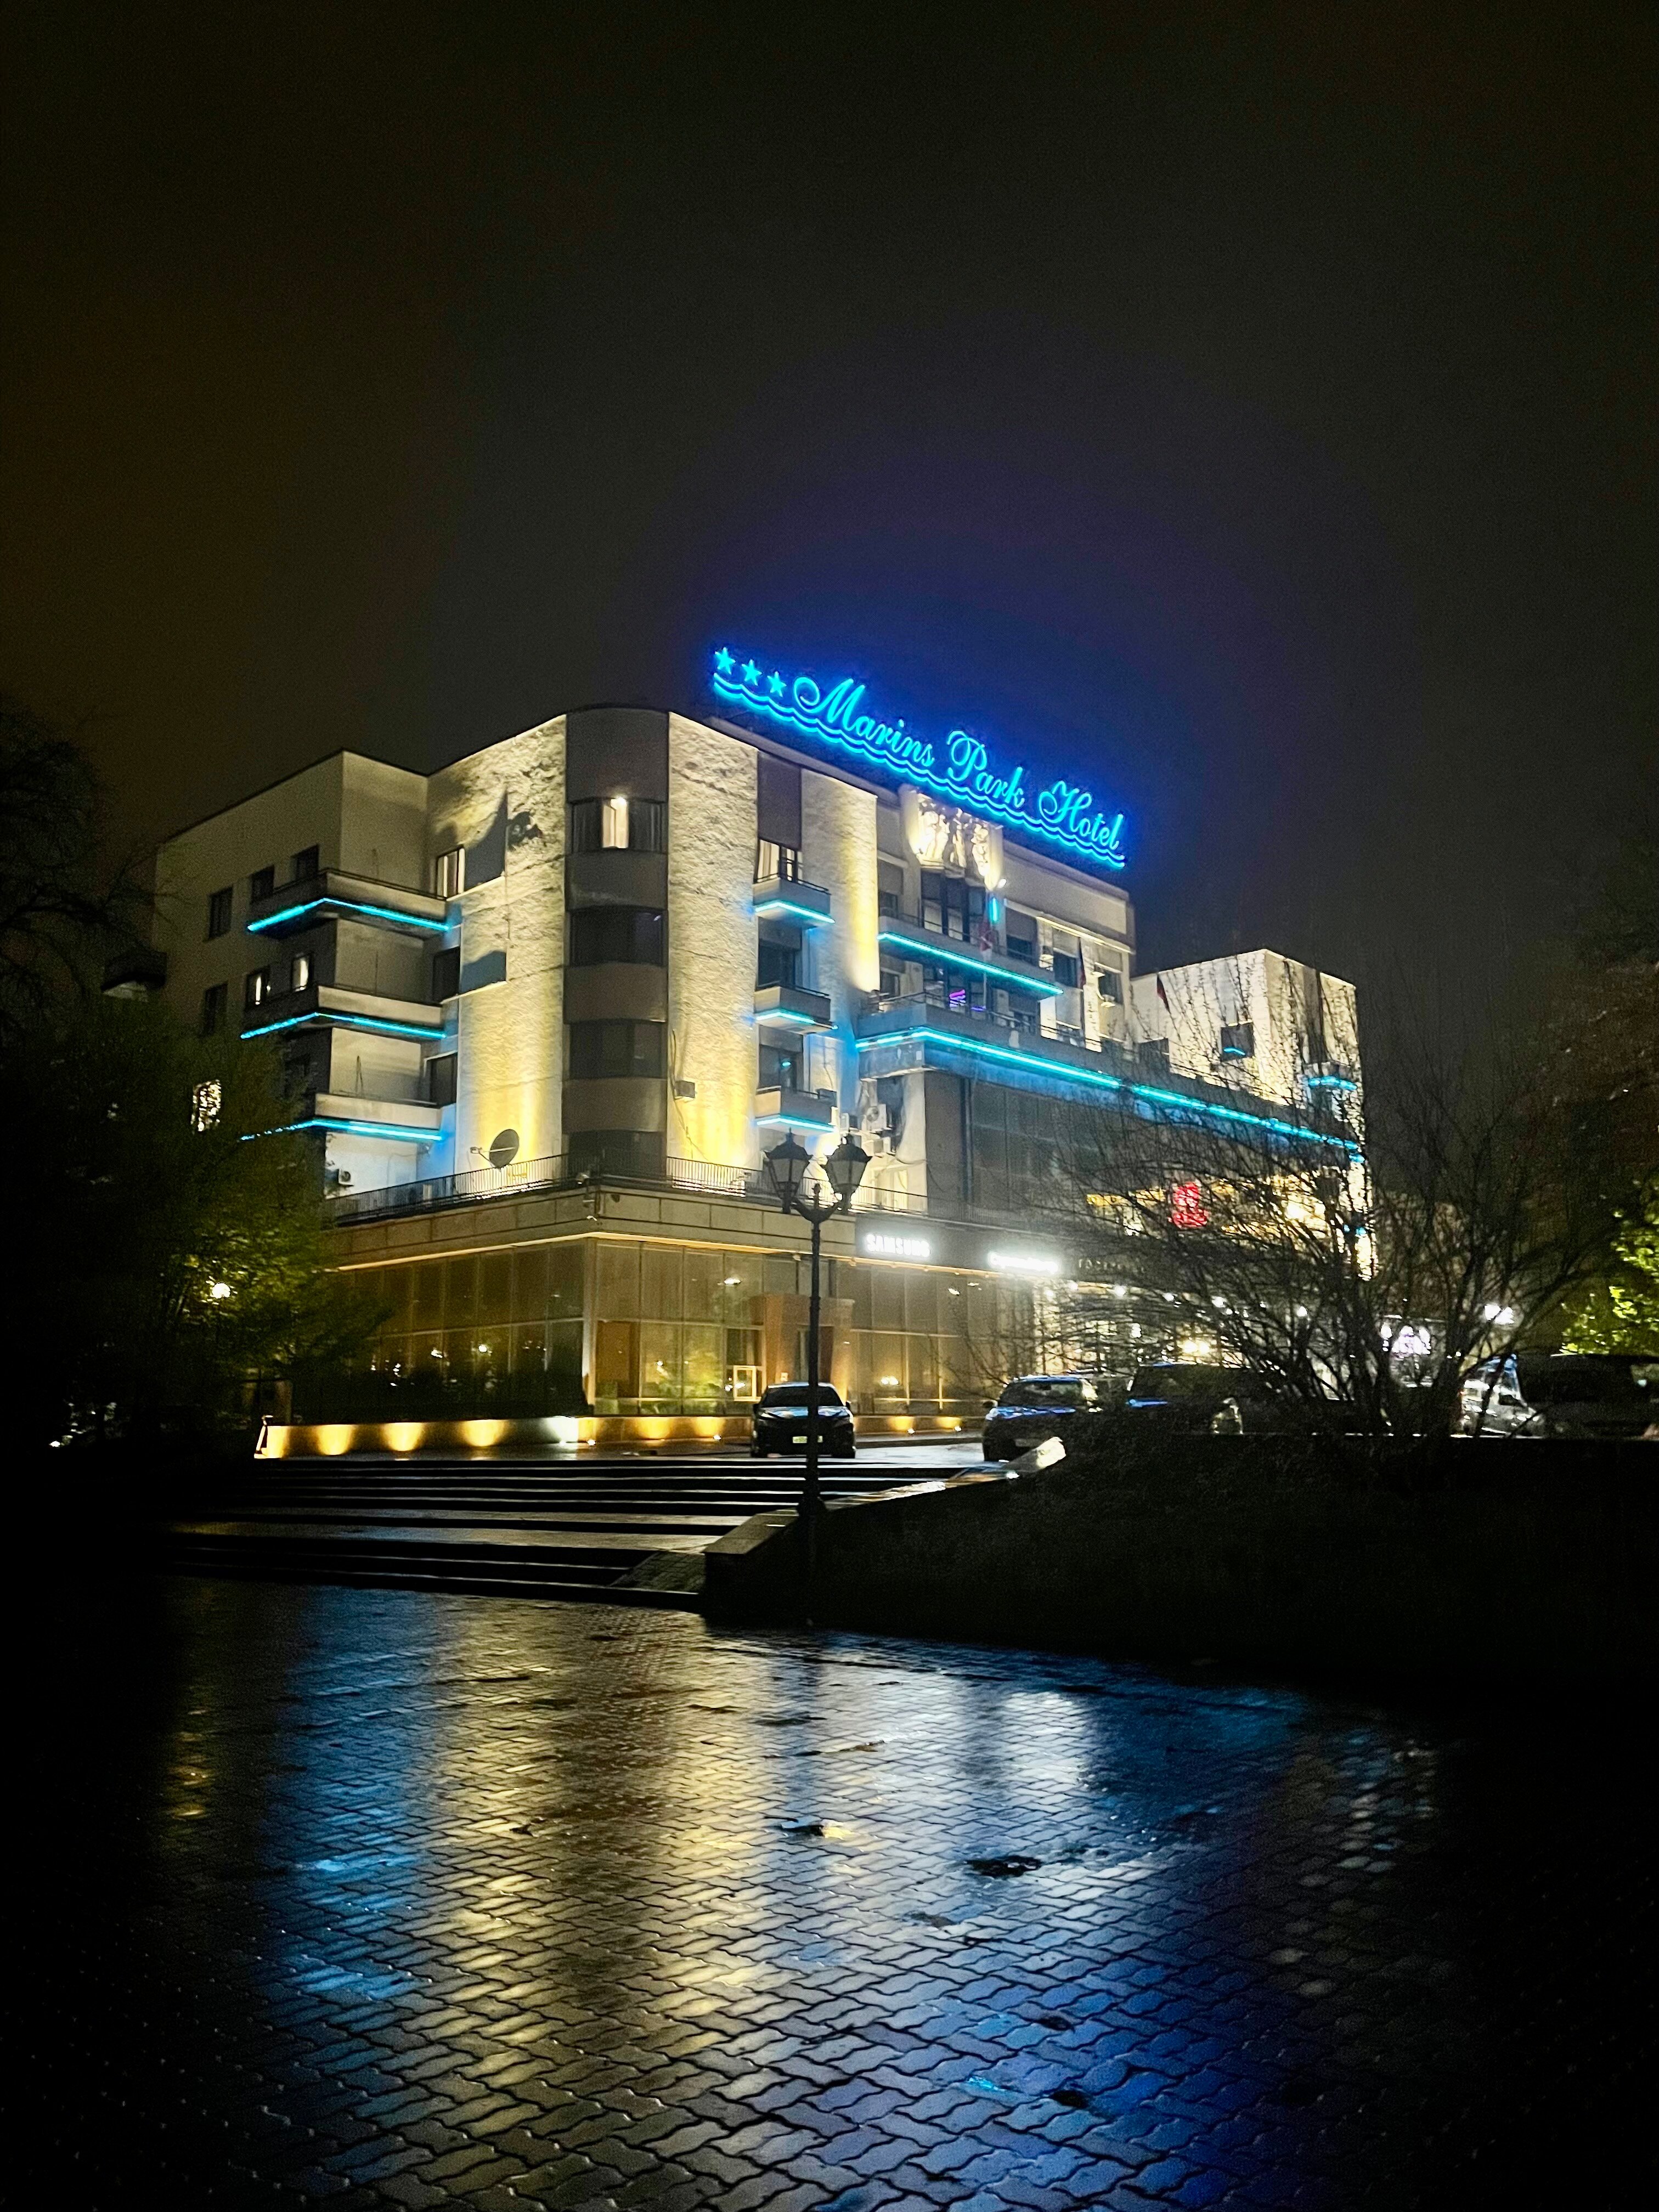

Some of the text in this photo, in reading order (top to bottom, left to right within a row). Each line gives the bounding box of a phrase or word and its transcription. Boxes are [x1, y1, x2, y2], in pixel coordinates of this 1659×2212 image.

[793, 677, 1124, 850] Marins Park Hotel
[866, 1234, 930, 1257] SAMSUNG
